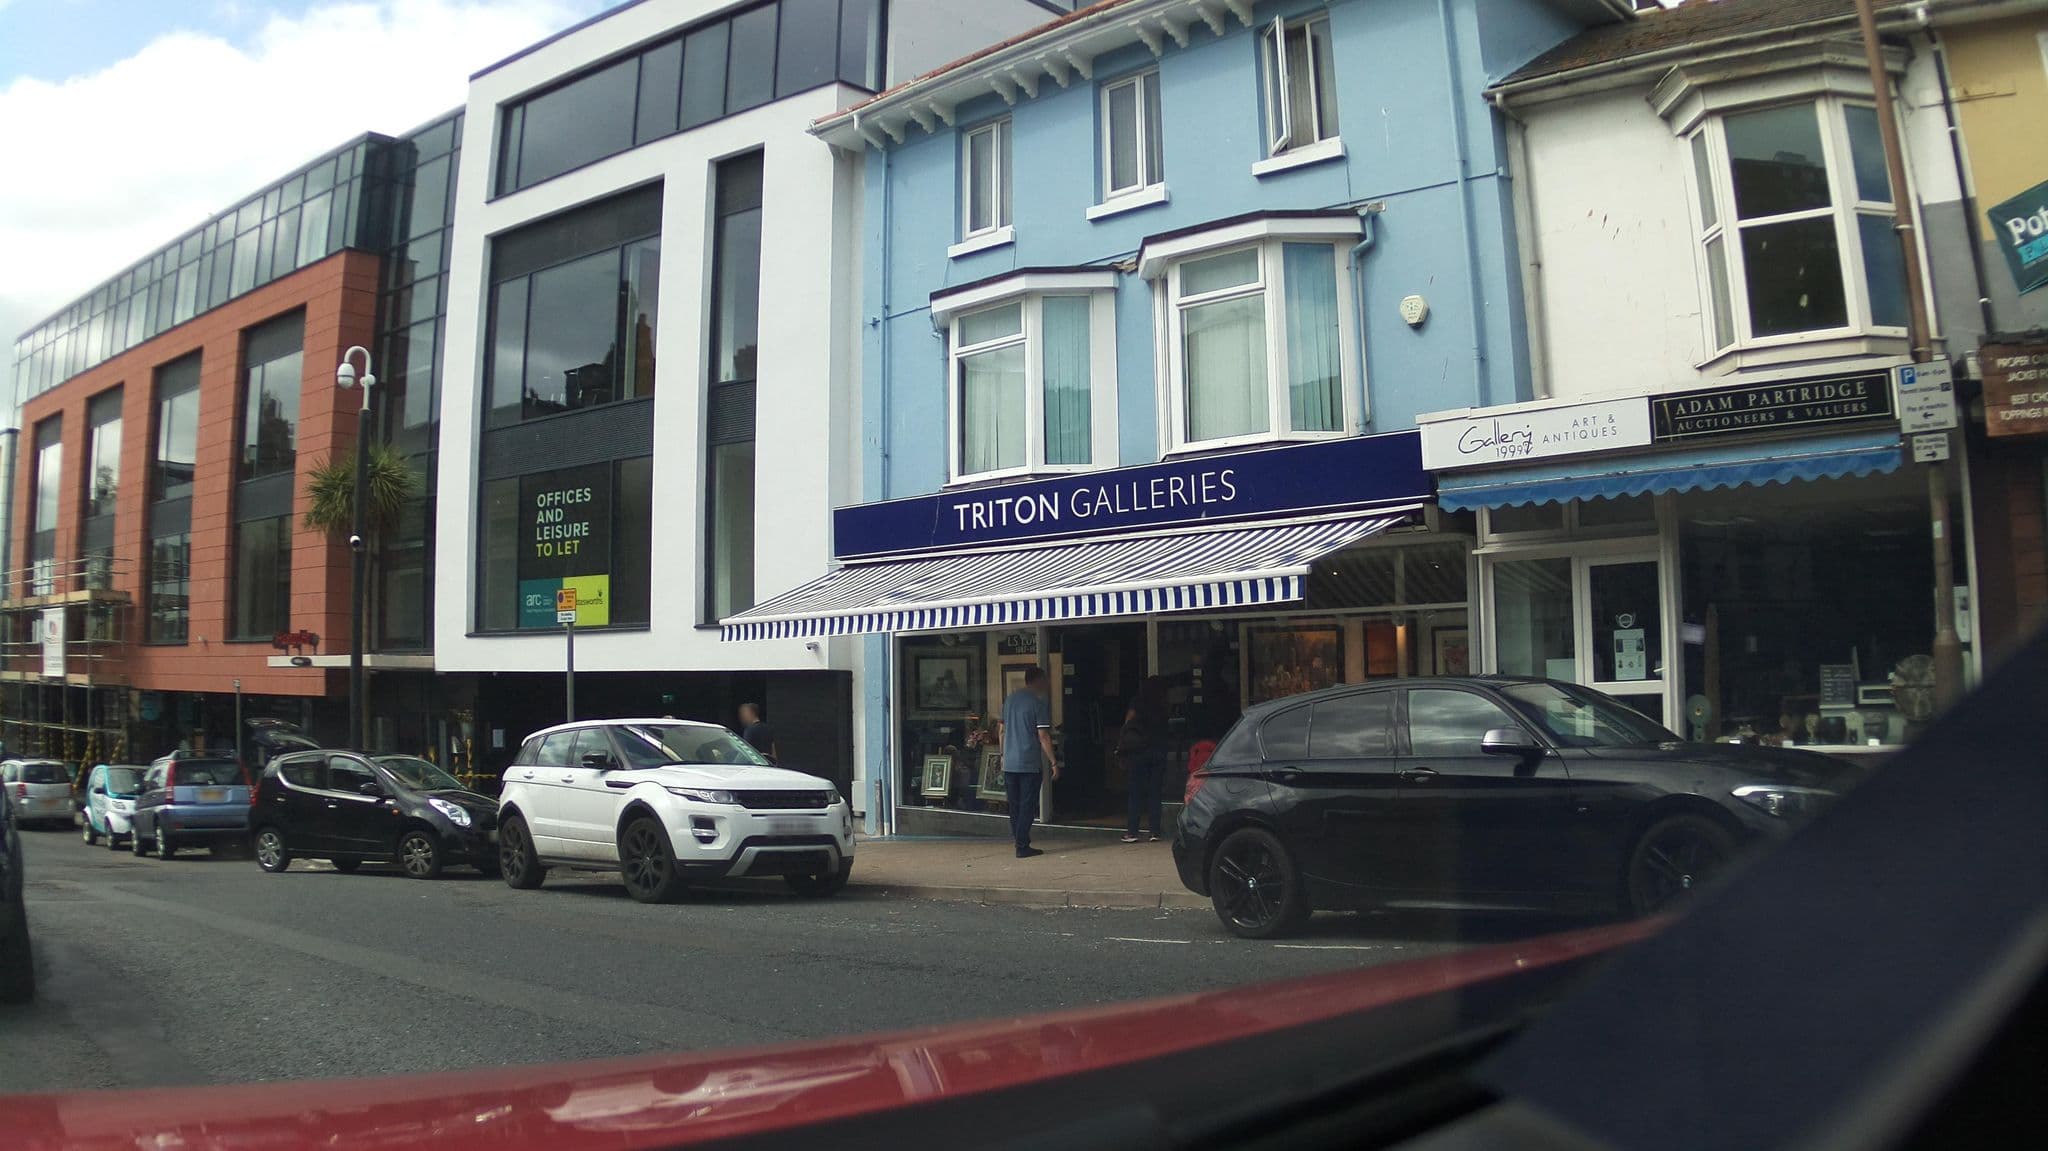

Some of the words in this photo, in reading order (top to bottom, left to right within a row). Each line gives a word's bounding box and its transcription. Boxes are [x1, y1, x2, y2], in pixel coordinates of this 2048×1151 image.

[1675, 396, 1733, 415] ADAM
[1749, 381, 1867, 407] PARTRIDGE
[1572, 415, 1597, 428] ART
[1607, 413, 1615, 424] &
[1677, 410, 1776, 432] AUCTIONEERS
[1786, 408, 1796, 419] &
[1806, 402, 1868, 417] VALUERS
[1457, 418, 1533, 456] Gallery
[1542, 425, 1618, 444] ANTIQUES
[537, 487, 592, 508] OFFICES
[954, 491, 1059, 531] TRITON
[1071, 469, 1237, 519] GALLERIES
[536, 508, 564, 524] AND
[536, 522, 590, 540] LEISURE
[536, 542, 553, 557] TO
[557, 540, 580, 555] LET
[526, 593, 542, 606] arc
